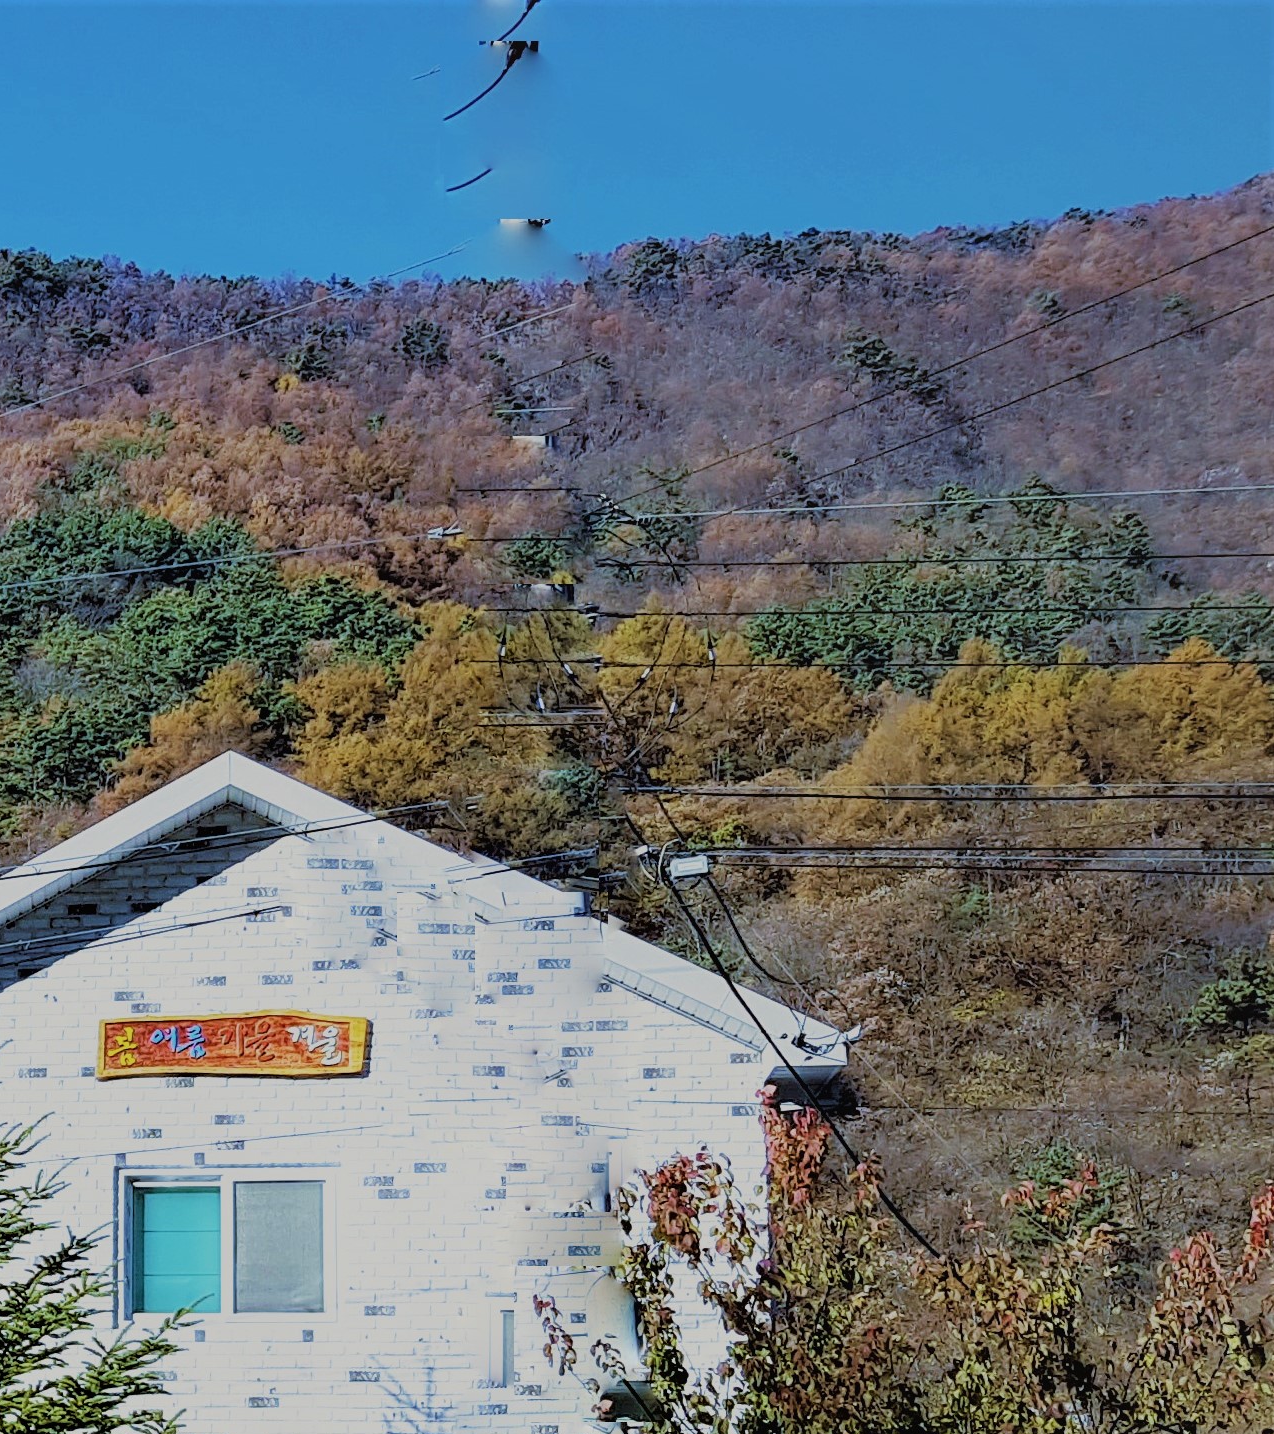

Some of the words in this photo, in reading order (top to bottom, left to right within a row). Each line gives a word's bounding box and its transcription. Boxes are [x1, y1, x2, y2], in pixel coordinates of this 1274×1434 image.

[108, 1026, 138, 1067] 봄
[150, 1025, 207, 1060] 여름
[219, 1021, 277, 1062] 가을
[288, 1025, 343, 1066] 겨울
